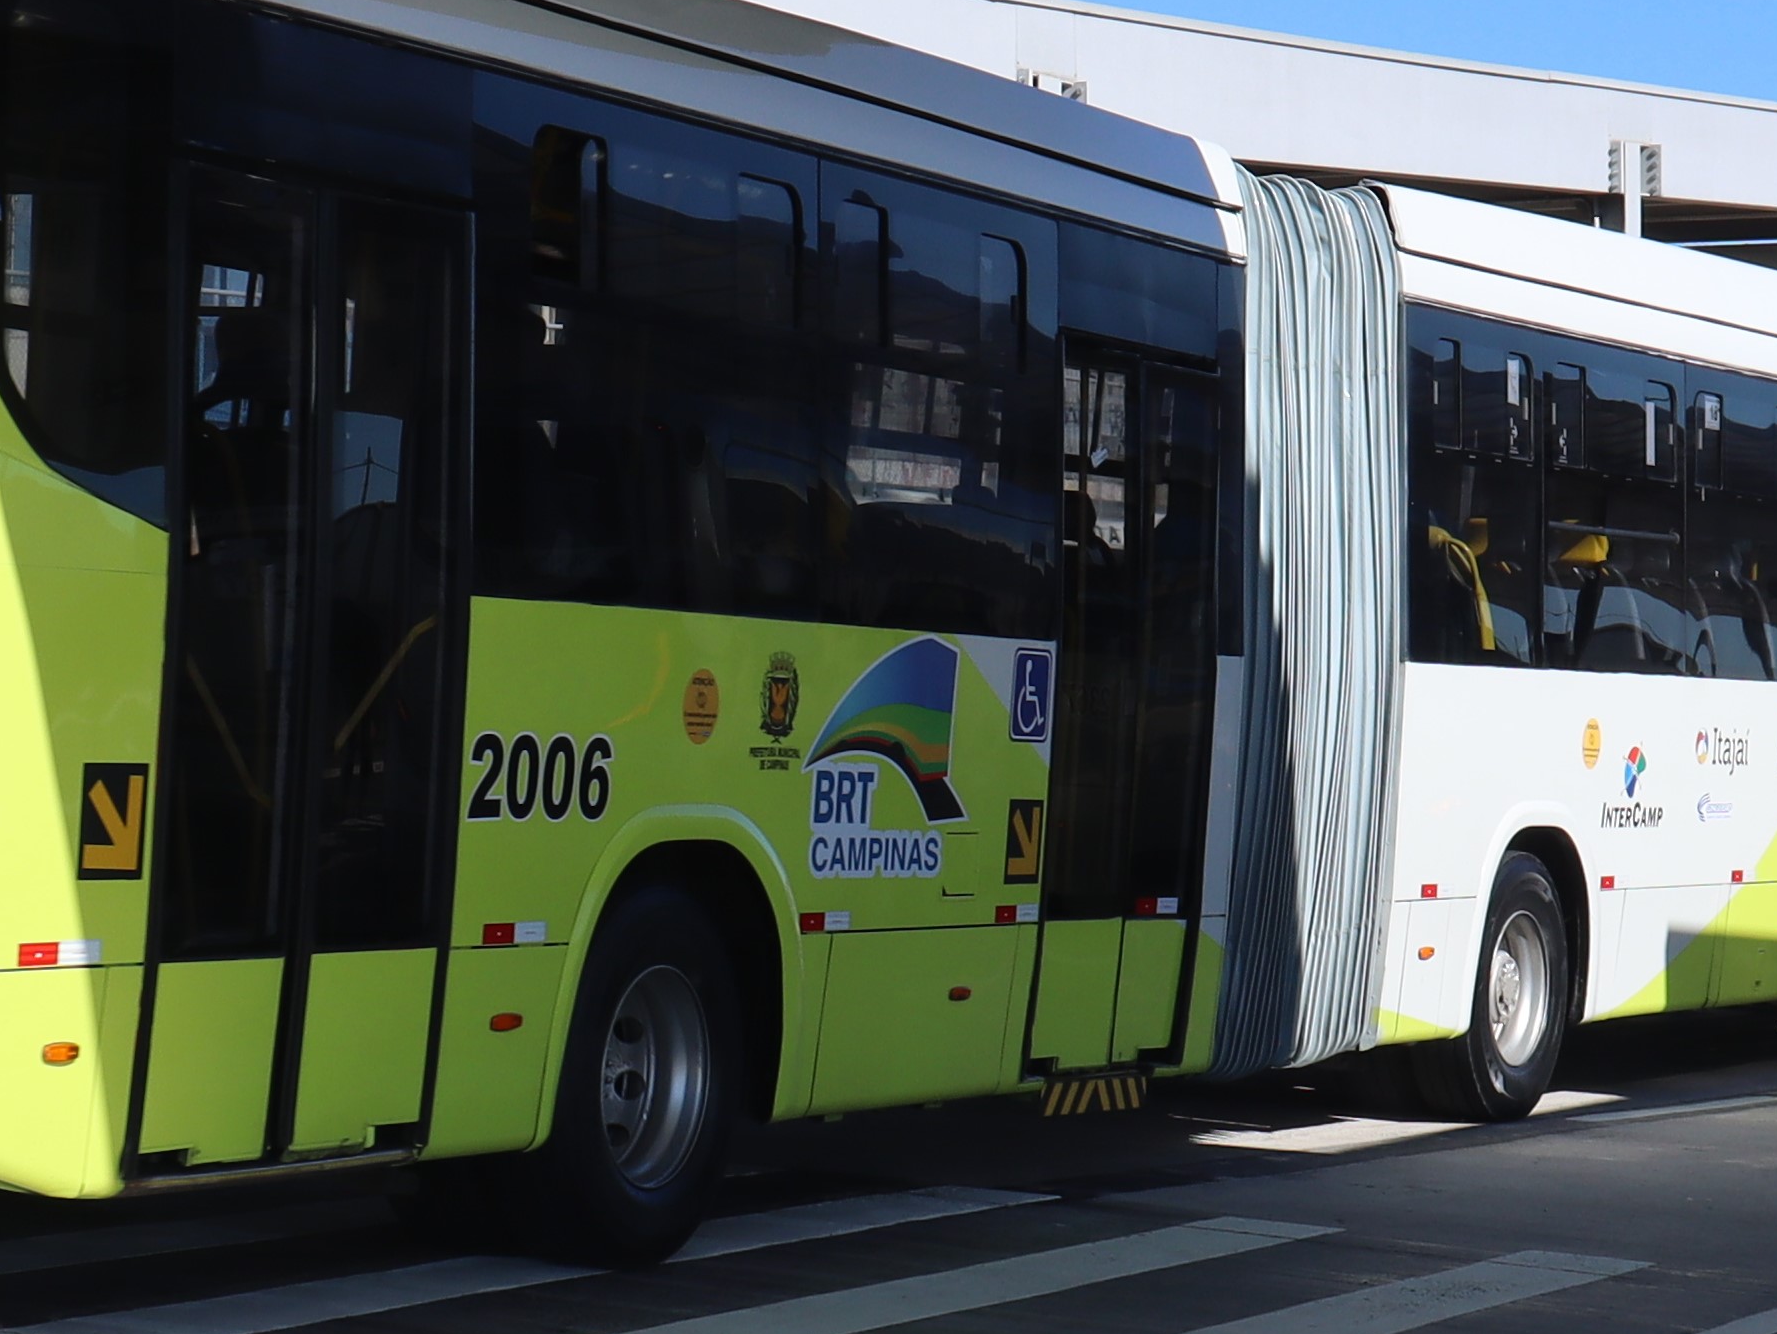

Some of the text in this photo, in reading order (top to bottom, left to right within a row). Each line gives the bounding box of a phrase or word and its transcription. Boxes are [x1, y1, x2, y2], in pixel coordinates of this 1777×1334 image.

[1712, 728, 1750, 775] Itajaí
[468, 732, 613, 822] 2006
[814, 771, 874, 825] BRT
[810, 834, 939, 873] CAMPINAS
